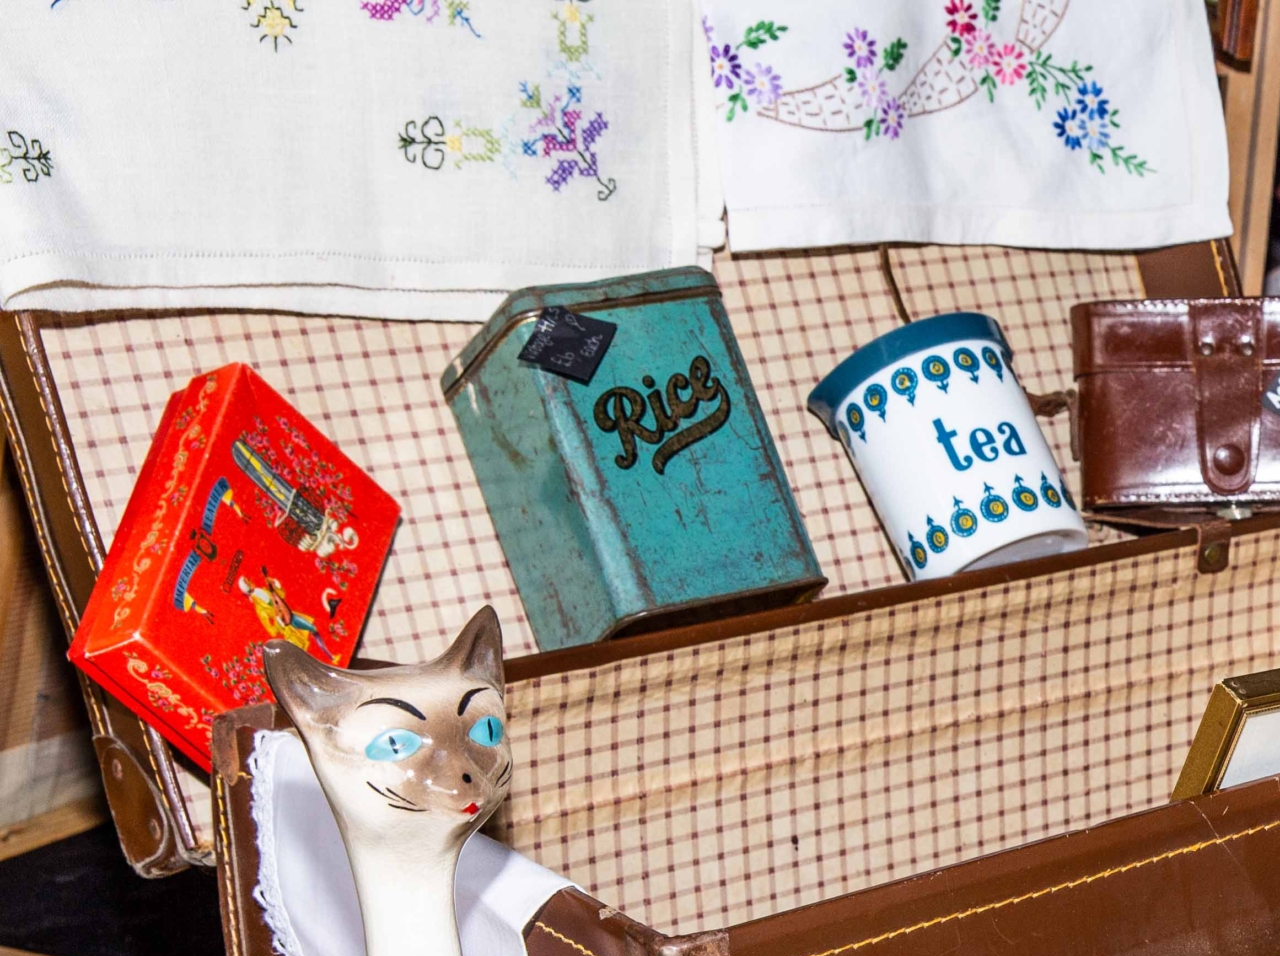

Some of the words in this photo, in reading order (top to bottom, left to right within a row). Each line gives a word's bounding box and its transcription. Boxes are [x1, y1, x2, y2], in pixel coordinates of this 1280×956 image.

[593, 355, 731, 476] Rice
[932, 417, 1028, 472] tea
[174, 551, 201, 607] IMPERIAL
